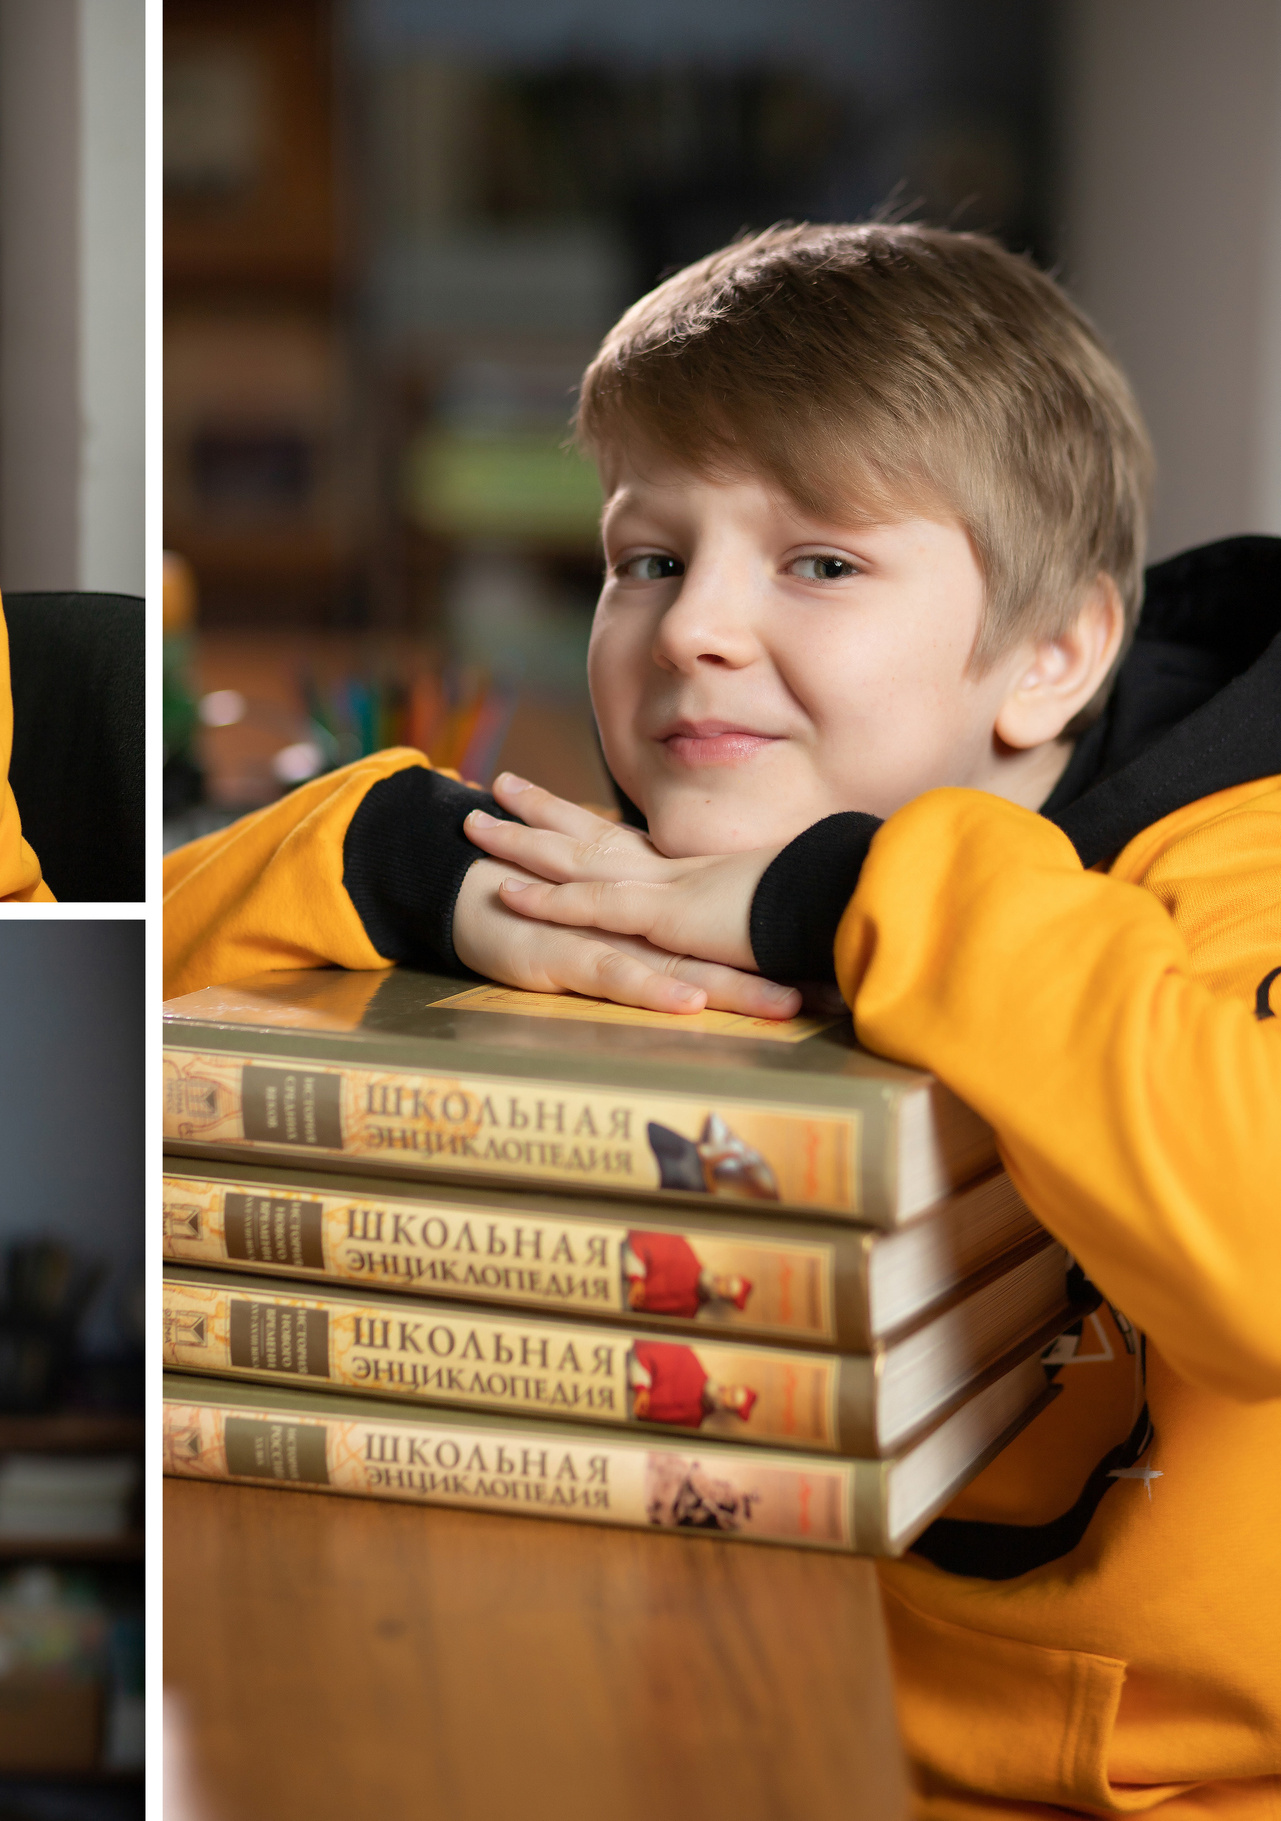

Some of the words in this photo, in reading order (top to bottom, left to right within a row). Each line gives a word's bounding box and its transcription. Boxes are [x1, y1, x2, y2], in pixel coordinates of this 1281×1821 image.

[265, 1087, 279, 1128] ВЕКОВ
[284, 1075, 298, 1140] СРЕДНИХ
[303, 1077, 317, 1143] ИСТОРИЯ
[364, 1083, 632, 1142] ШКОЛЬНАЯ
[363, 1124, 633, 1175] ЭНЦИКЛОПЕДИЯ
[260, 1201, 272, 1260] ВРЕМЕНИ
[275, 1207, 287, 1260] НОВОГО
[290, 1202, 304, 1266] ИСТОРИЯ
[347, 1209, 609, 1268] ШКОЛЬНАЯ
[346, 1249, 610, 1302] ЭНЦИКЛОПЕДИЯ
[266, 1309, 277, 1369] ВРЕМЕНИ
[282, 1314, 293, 1368] НОВОГО
[297, 1310, 309, 1374] ИСТОРИЯ
[353, 1316, 616, 1377] ШКОЛЬНАЯ
[352, 1356, 616, 1411] ЭНЦИКЛОПЕДИЯ
[365, 1432, 610, 1484] ШКОЛЬНАЯ
[365, 1465, 611, 1510] ЭНЦИКЛОПЕДИЯ
